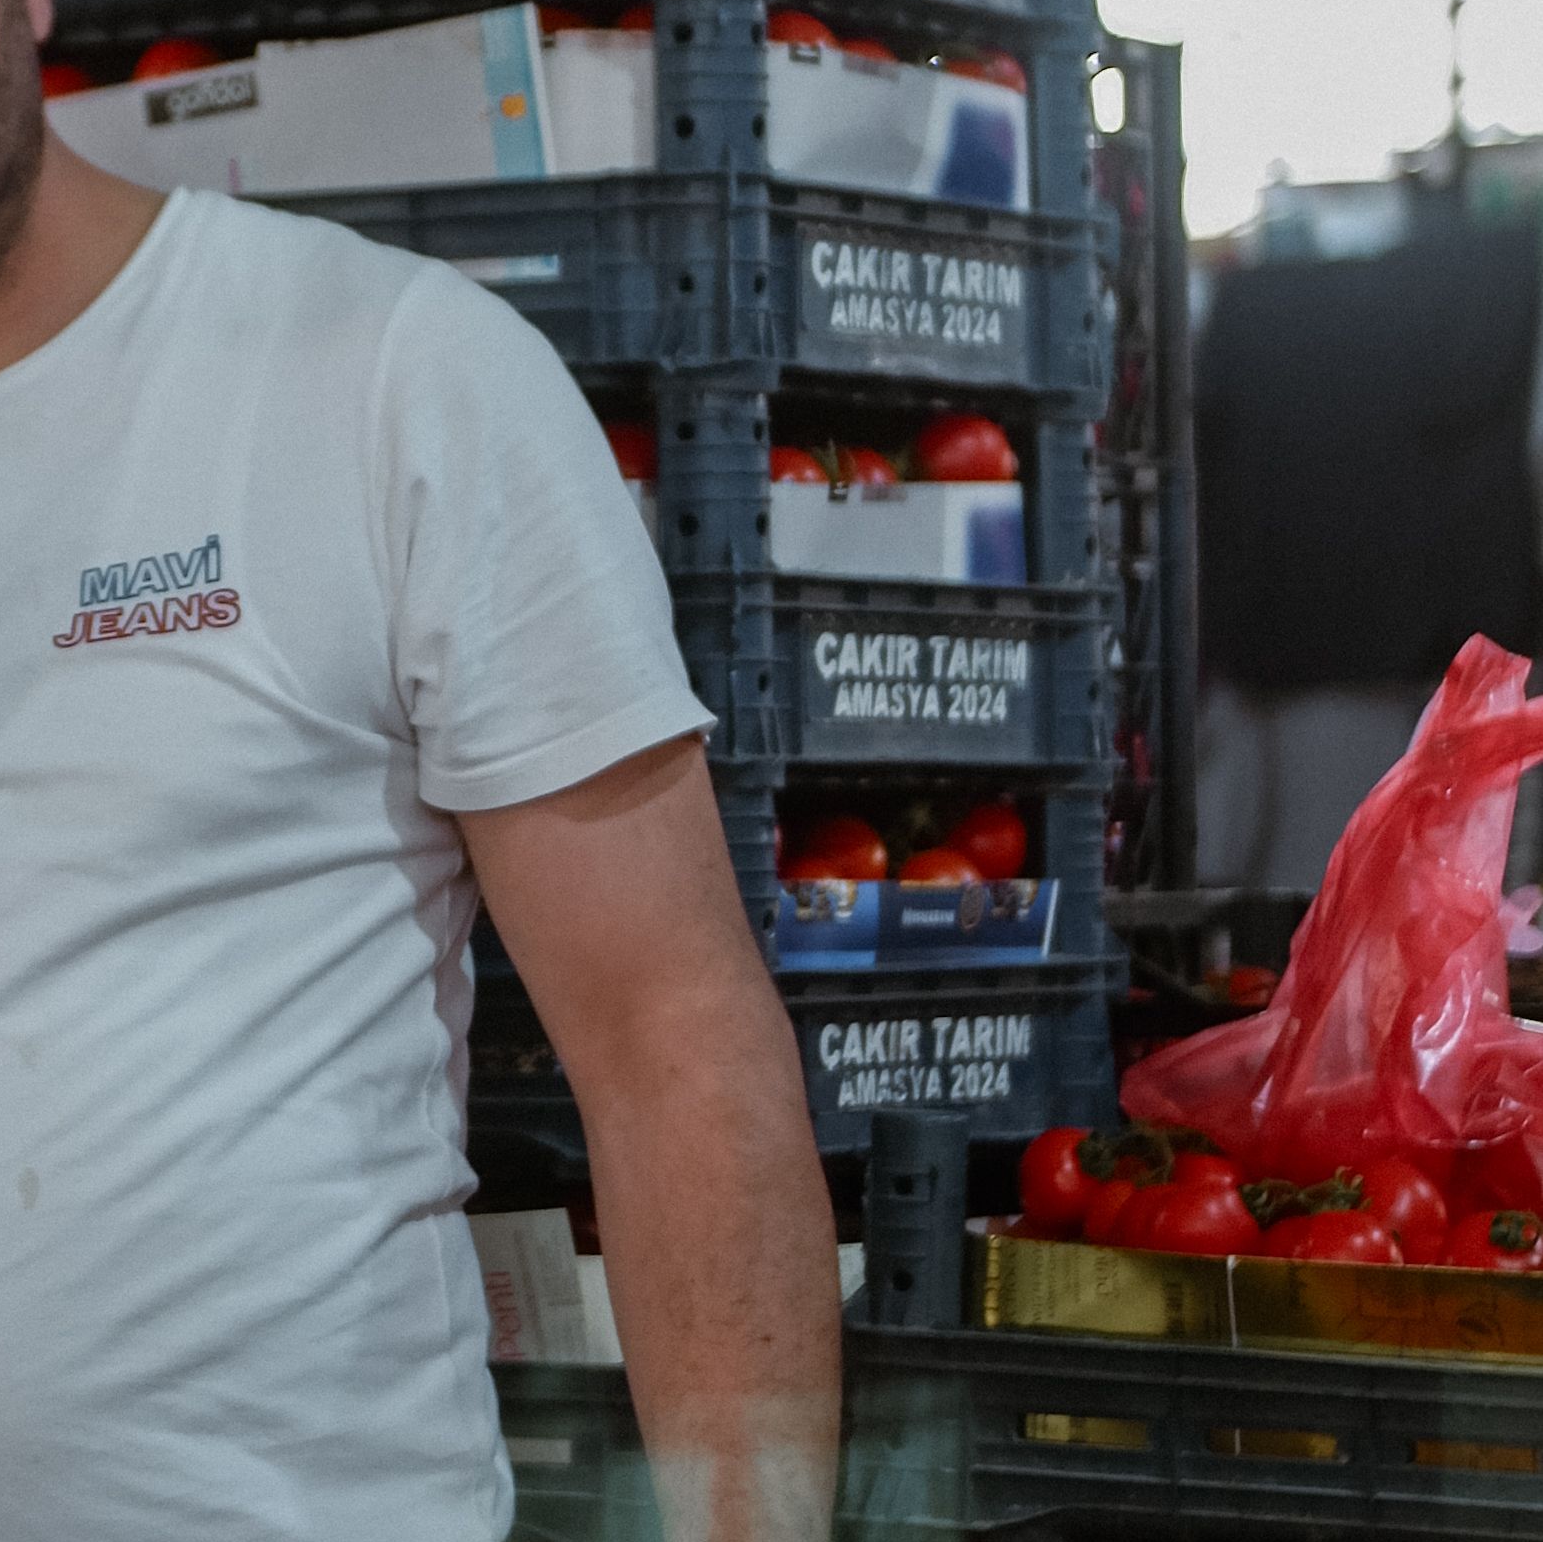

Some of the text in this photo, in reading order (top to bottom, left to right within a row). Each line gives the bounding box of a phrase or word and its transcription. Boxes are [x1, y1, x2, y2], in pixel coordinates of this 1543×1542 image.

[922, 253, 1021, 306] TARIM
[830, 293, 1000, 343] AMASYA 2024
[53, 588, 241, 647] JEANS
[929, 635, 1028, 688] TARIM
[834, 680, 1007, 722] AMASYA 2024
[931, 1014, 1031, 1060] TARIM
[838, 1061, 1010, 1107] AMASYA 2024
